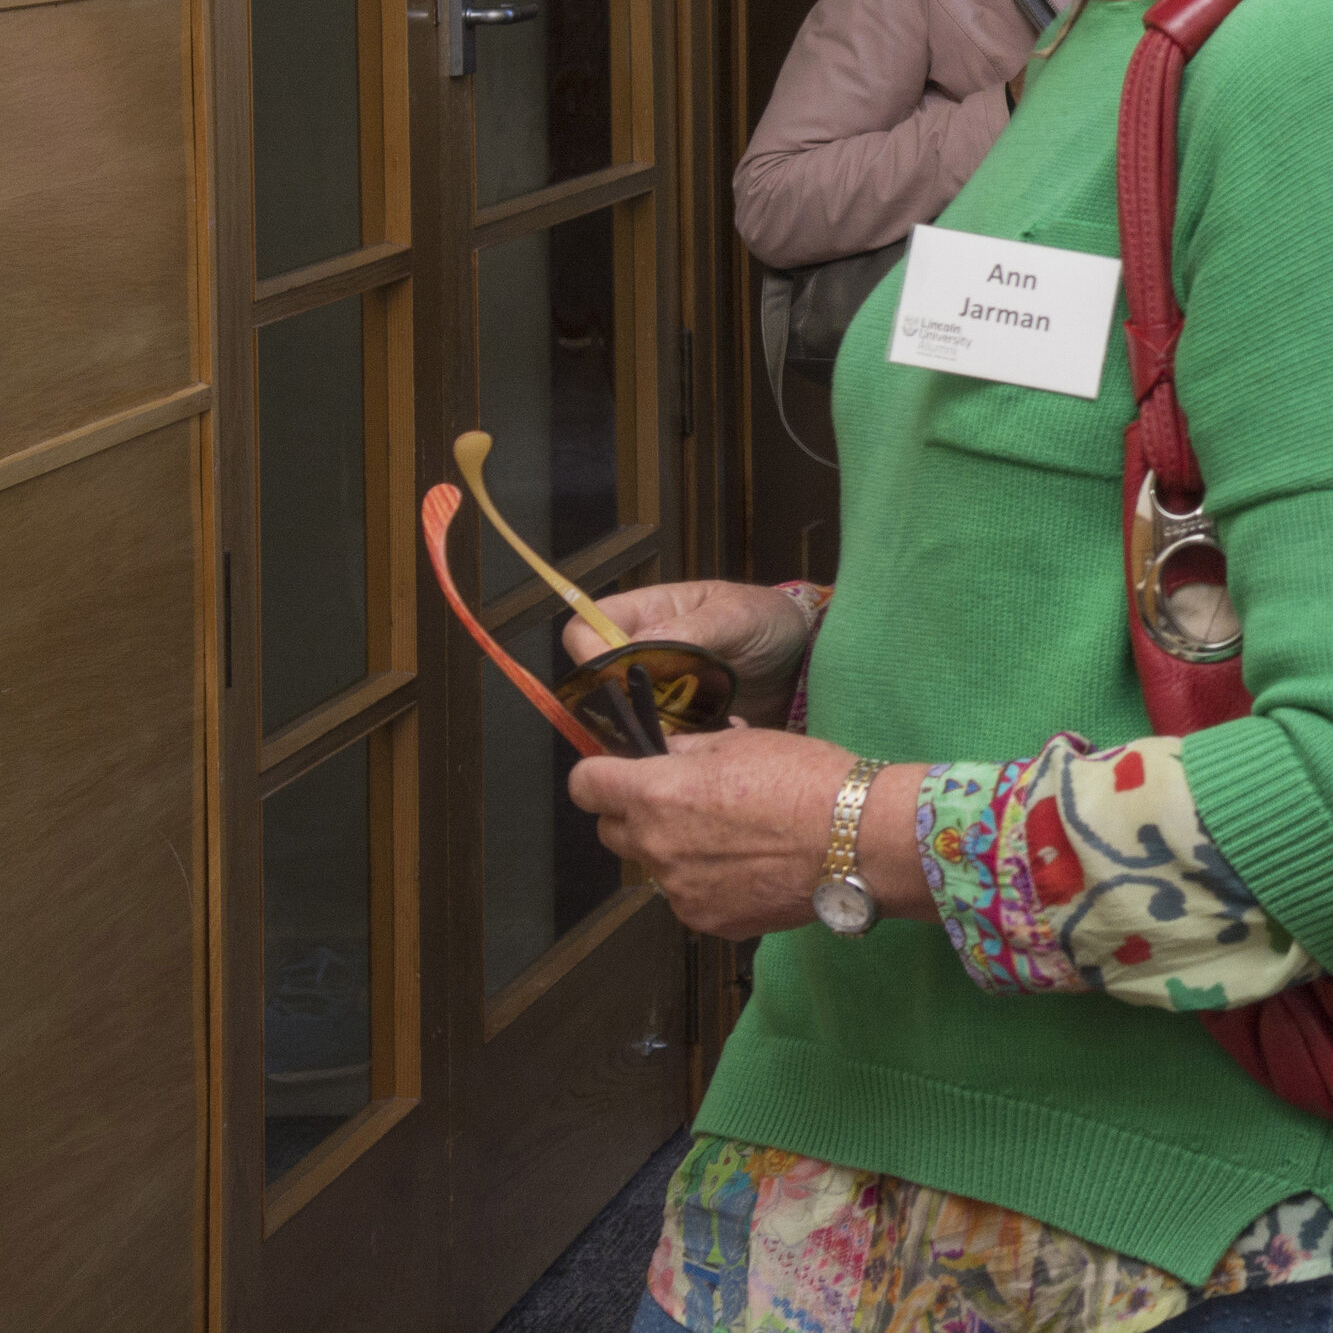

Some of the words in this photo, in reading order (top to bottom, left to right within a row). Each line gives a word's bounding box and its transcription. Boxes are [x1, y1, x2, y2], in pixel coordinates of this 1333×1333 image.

[986, 263, 1038, 291] Ann
[920, 316, 961, 334] Lincoln
[959, 297, 1051, 332] Jarman
